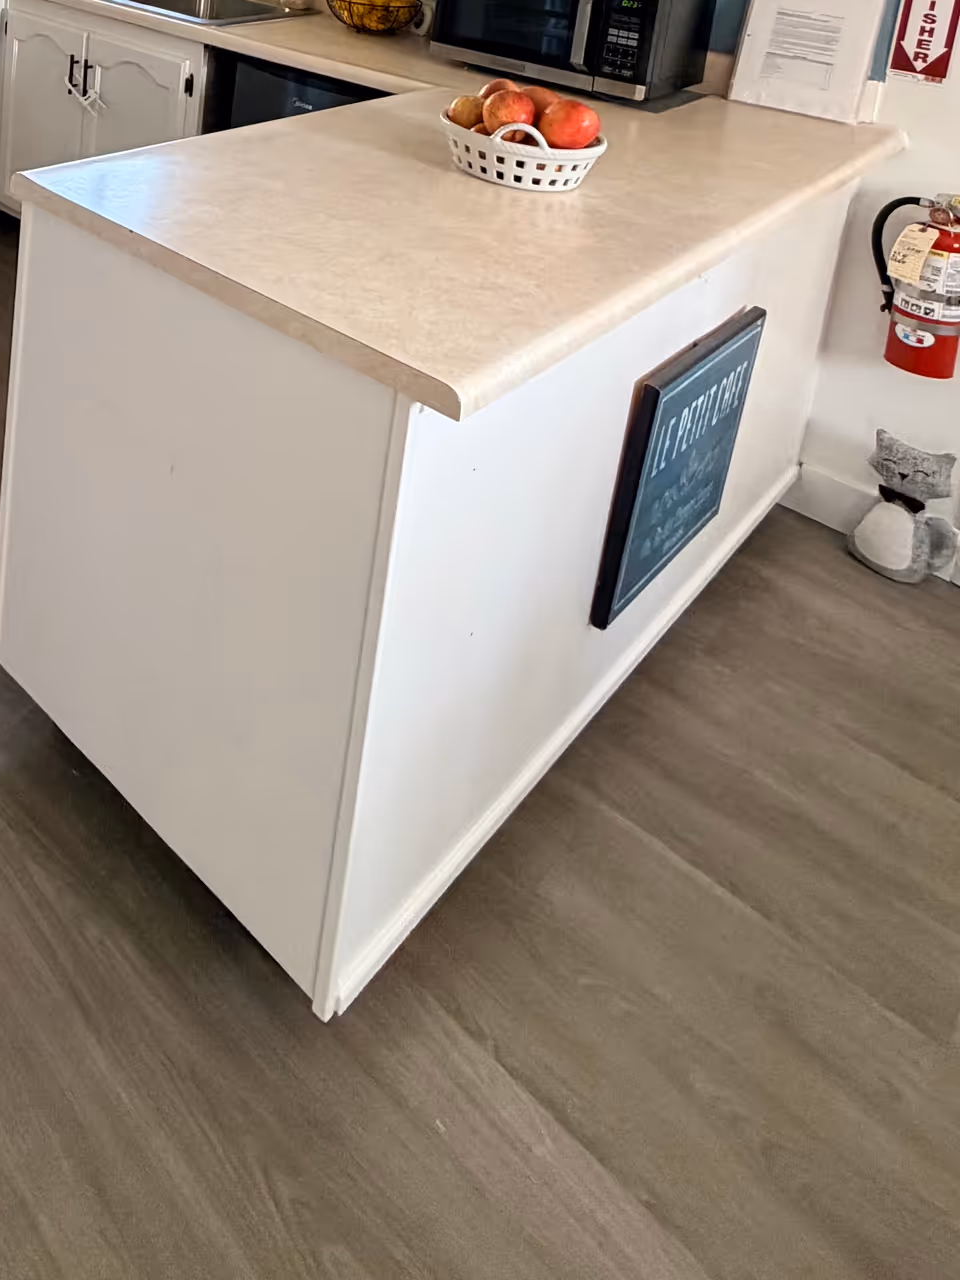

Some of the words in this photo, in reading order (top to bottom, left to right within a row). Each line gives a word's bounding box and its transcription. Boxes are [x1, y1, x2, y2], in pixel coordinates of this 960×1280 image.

[651, 416, 676, 479] LE
[672, 383, 718, 460] PETIT
[711, 360, 748, 427] CAFE
